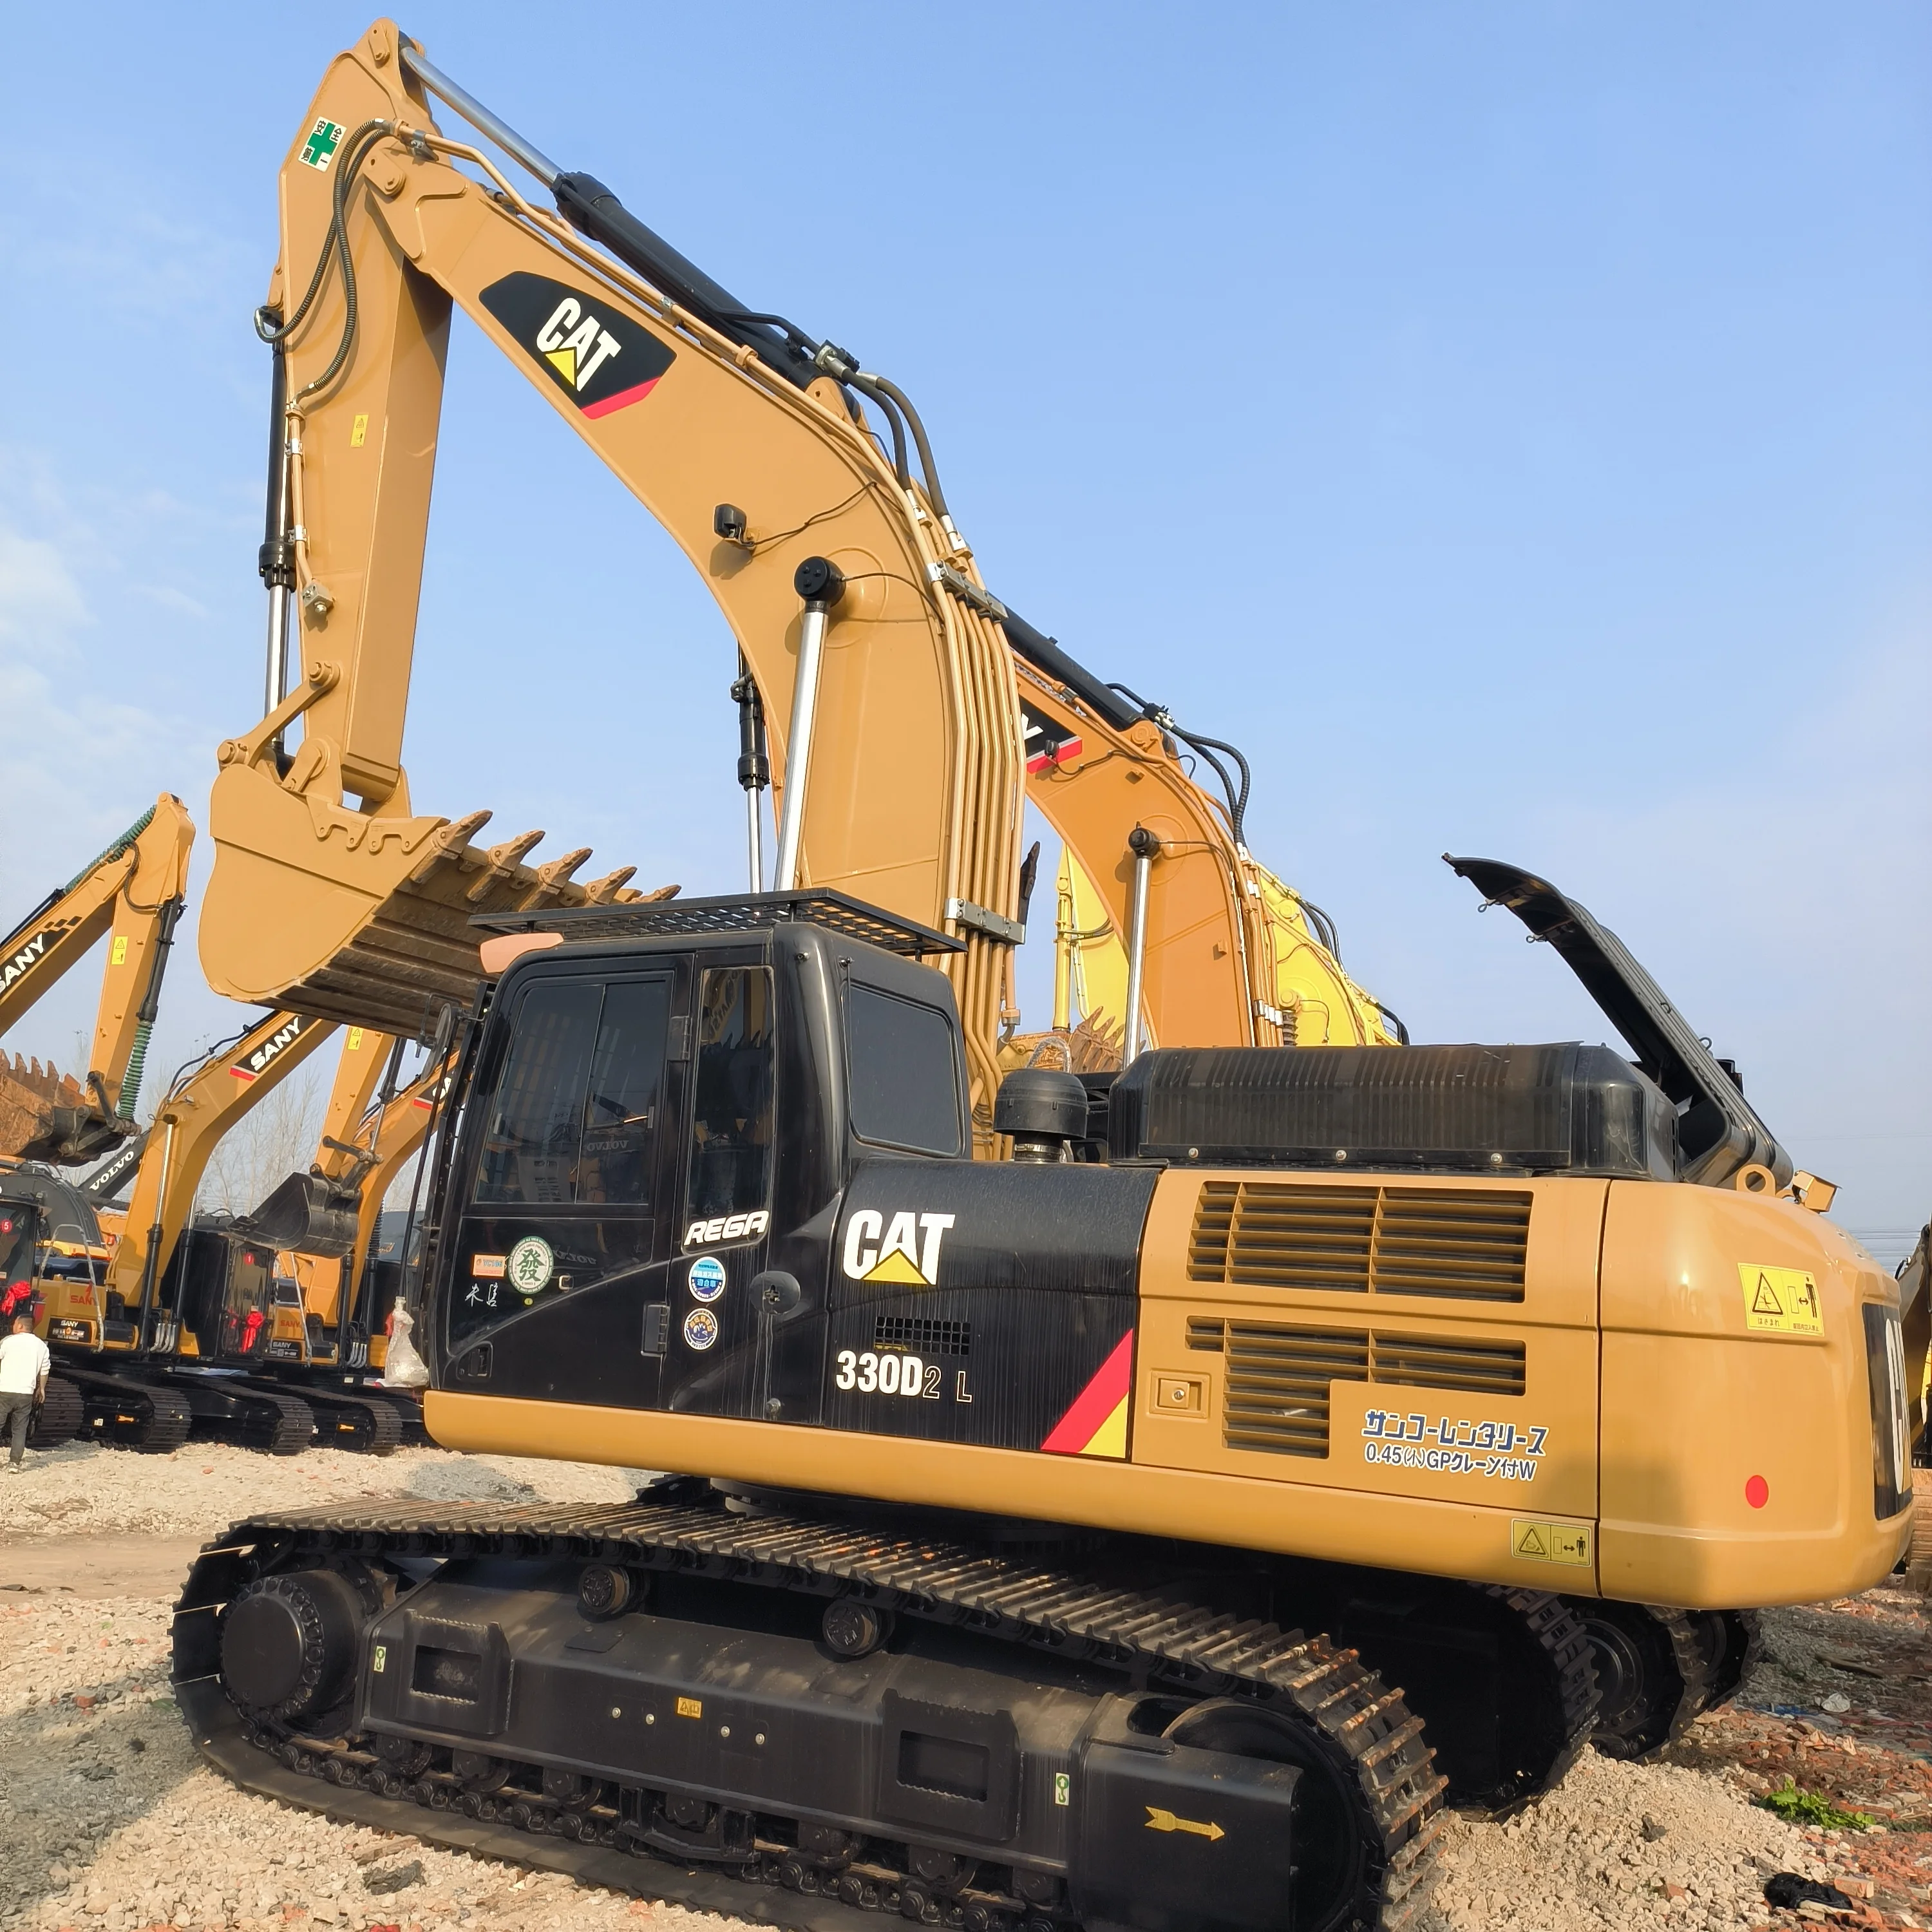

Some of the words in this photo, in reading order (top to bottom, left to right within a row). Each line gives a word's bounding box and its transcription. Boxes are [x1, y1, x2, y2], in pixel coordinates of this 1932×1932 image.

[536, 298, 622, 392] CAT
[251, 1016, 300, 1072] SANY
[88, 1151, 135, 1191] VOLVO
[683, 1210, 770, 1246] REGA
[842, 1209, 956, 1285] CAT
[517, 1247, 545, 1282] 發
[956, 1370, 972, 1403] L
